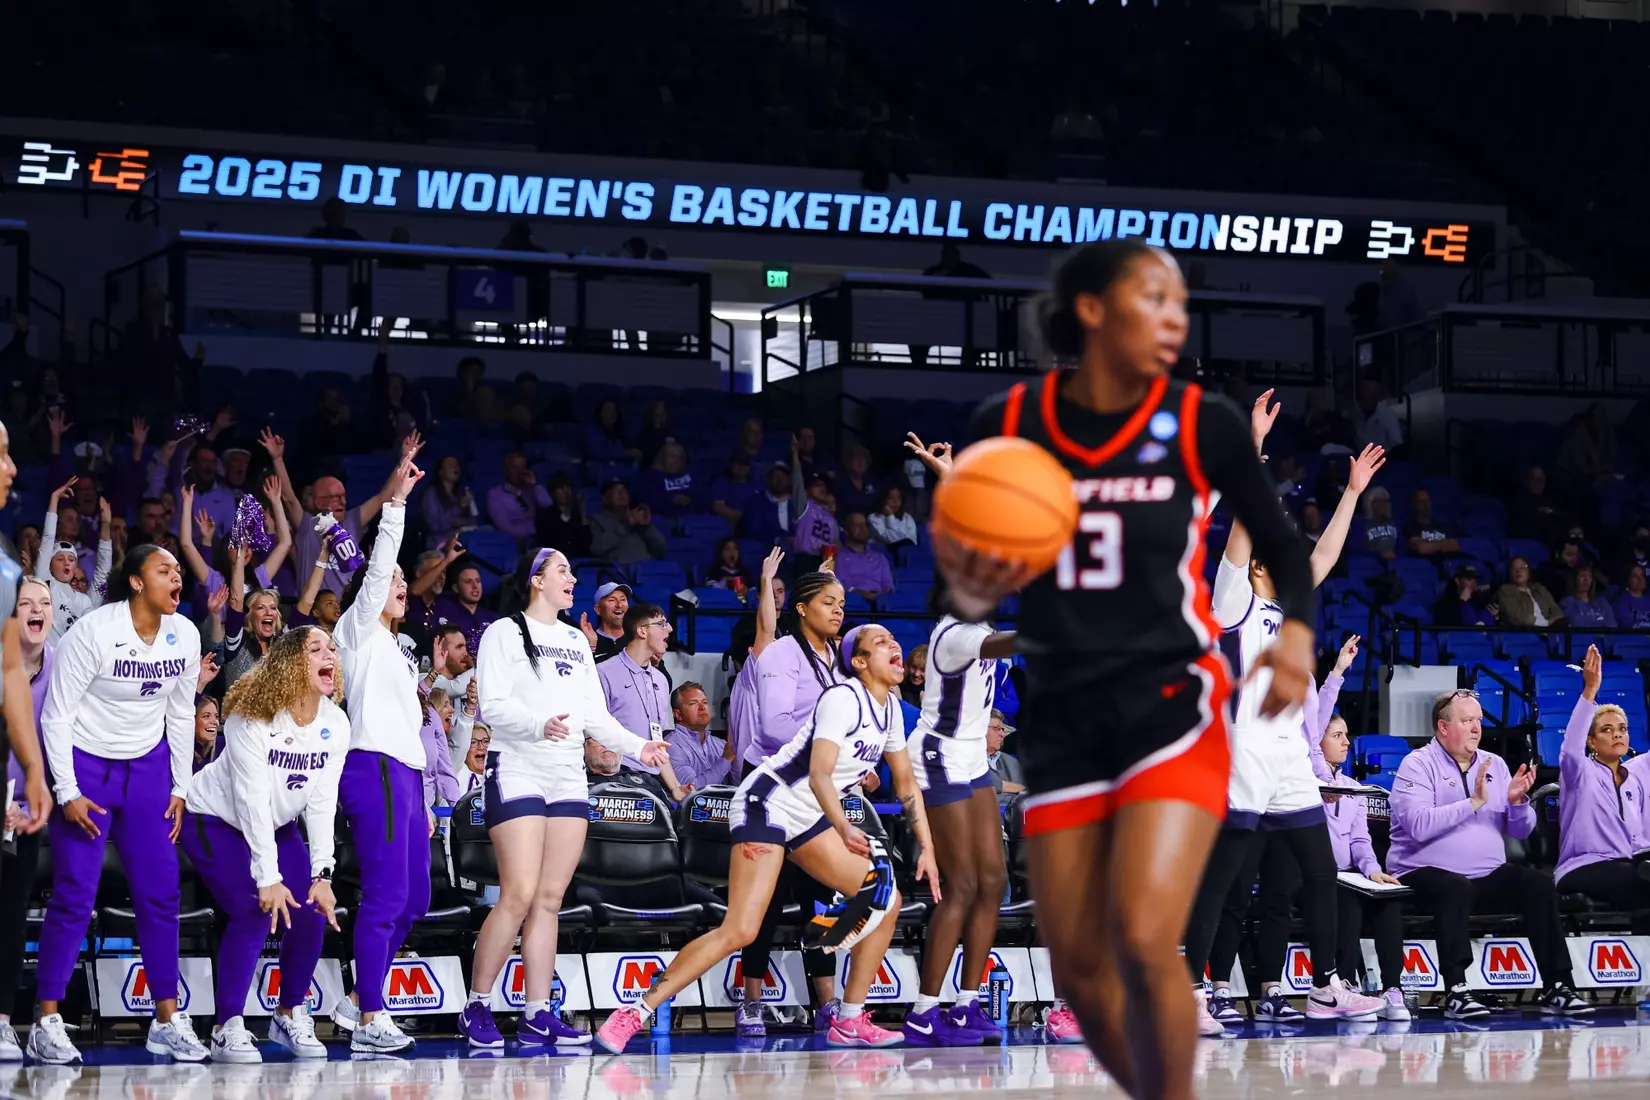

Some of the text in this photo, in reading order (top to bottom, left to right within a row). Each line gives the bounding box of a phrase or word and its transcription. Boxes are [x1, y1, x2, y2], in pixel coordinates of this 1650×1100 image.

[178, 154, 1344, 255] 2025 DI WOMEN'S BASKETBALL CHAMPIONSHIP
[473, 276, 496, 304] 4
[766, 270, 789, 288] EXIT
[1073, 476, 1176, 502] FIELD
[335, 538, 357, 561] 00
[1056, 510, 1123, 590] 13
[112, 657, 186, 679] NOTHING EASY
[598, 798, 636, 810] MARCH
[604, 808, 654, 820] MADNESS
[706, 798, 730, 809] MAR
[1489, 946, 1528, 972] M
[1597, 945, 1633, 970] M
[388, 967, 435, 996] M
[1400, 974, 1433, 982] arathon
[1489, 972, 1531, 980] Marathon
[1597, 970, 1637, 978] Marathon
[868, 985, 895, 994] athon
[992, 980, 1000, 1019] POWERADE
[388, 996, 438, 1006] Marathon
